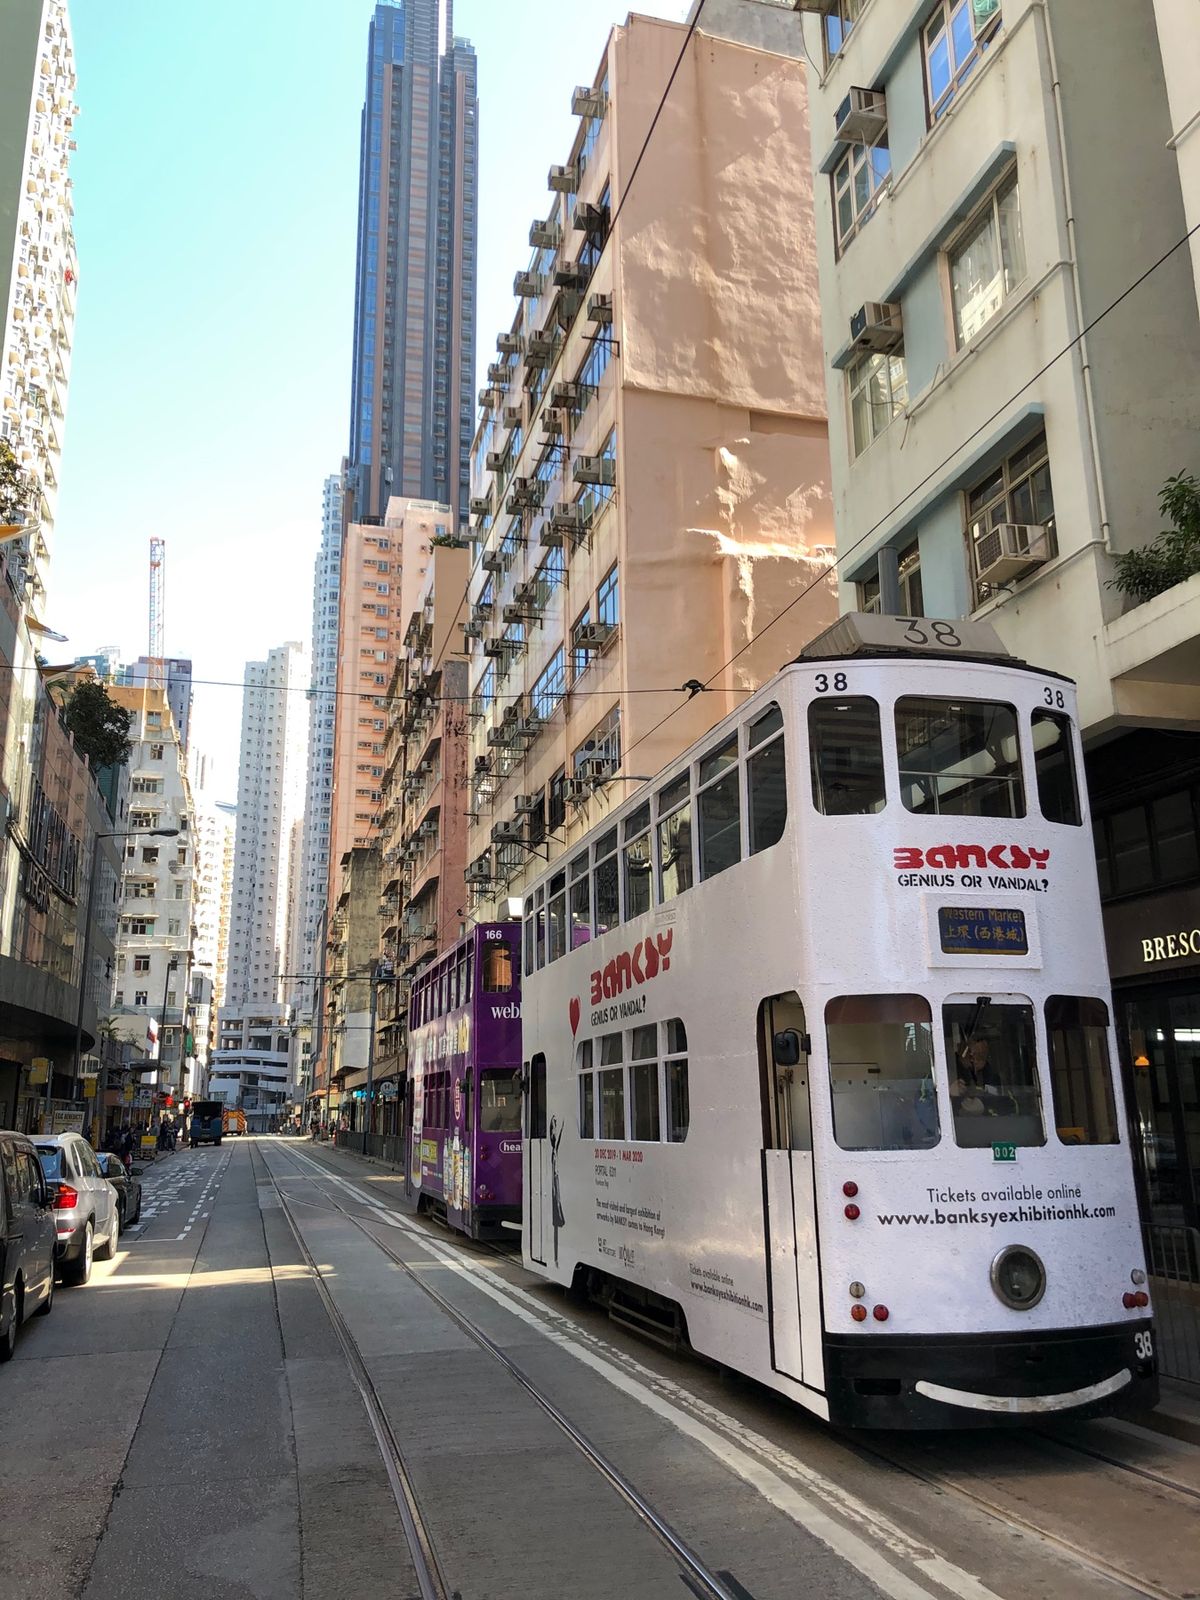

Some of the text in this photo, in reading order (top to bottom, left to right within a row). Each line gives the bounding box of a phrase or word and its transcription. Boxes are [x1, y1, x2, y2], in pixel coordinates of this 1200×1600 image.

[895, 618, 962, 648] 38
[814, 672, 848, 694] 38
[1043, 686, 1065, 709] 38
[898, 873, 1049, 893] GENIUS OR VANDAL?
[485, 930, 503, 940] 166
[590, 994, 647, 1027] GENIUS OR VANDAL?
[994, 1146, 1015, 1158] 002
[926, 1184, 1082, 1203] Tickets available online
[877, 1204, 1116, 1227] www.banksyexhibitionhk.com
[1134, 1331, 1153, 1359] 38
